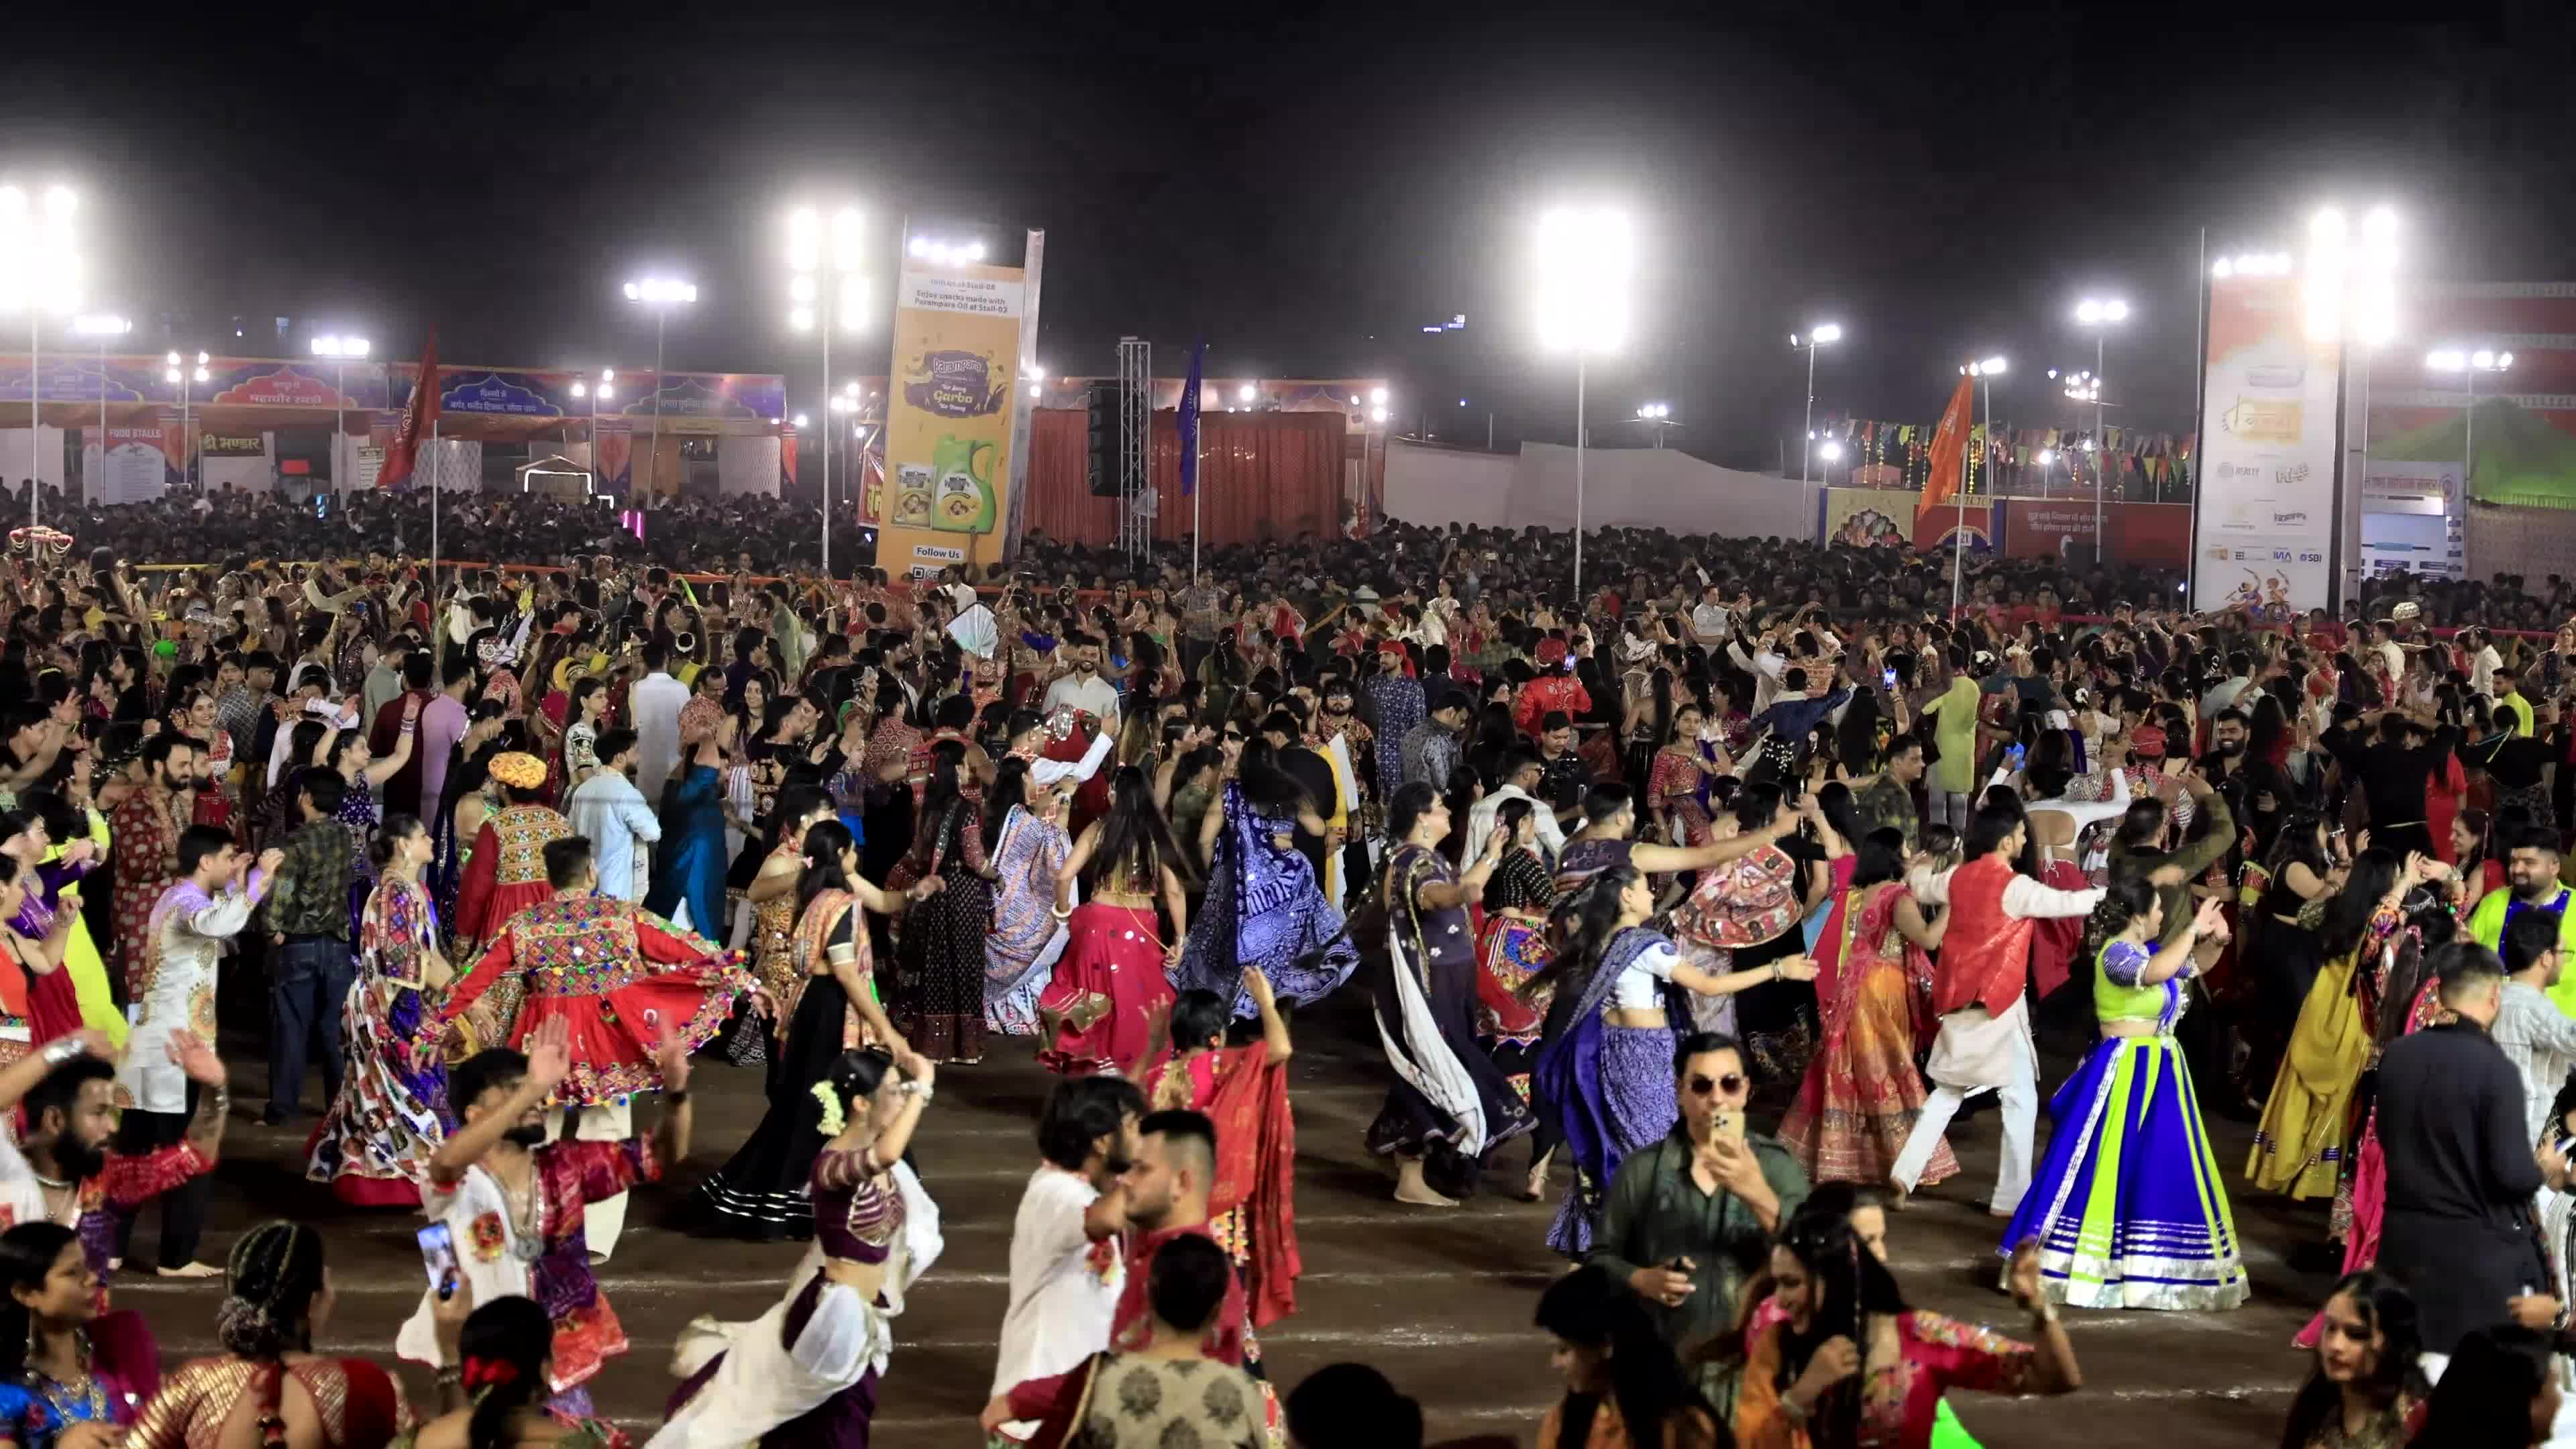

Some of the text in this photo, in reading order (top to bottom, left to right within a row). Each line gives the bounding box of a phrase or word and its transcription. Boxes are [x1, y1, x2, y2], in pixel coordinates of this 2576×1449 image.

[916, 289, 937, 299] Enjoy
[939, 293, 964, 302] snacks
[966, 296, 987, 304] made
[914, 297, 956, 309] Parampara
[969, 303, 977, 311] at
[933, 357, 982, 374] Parampara
[933, 389, 973, 403] Garba
[916, 547, 960, 558] Follow Us
[2308, 553, 2322, 563] SBI
